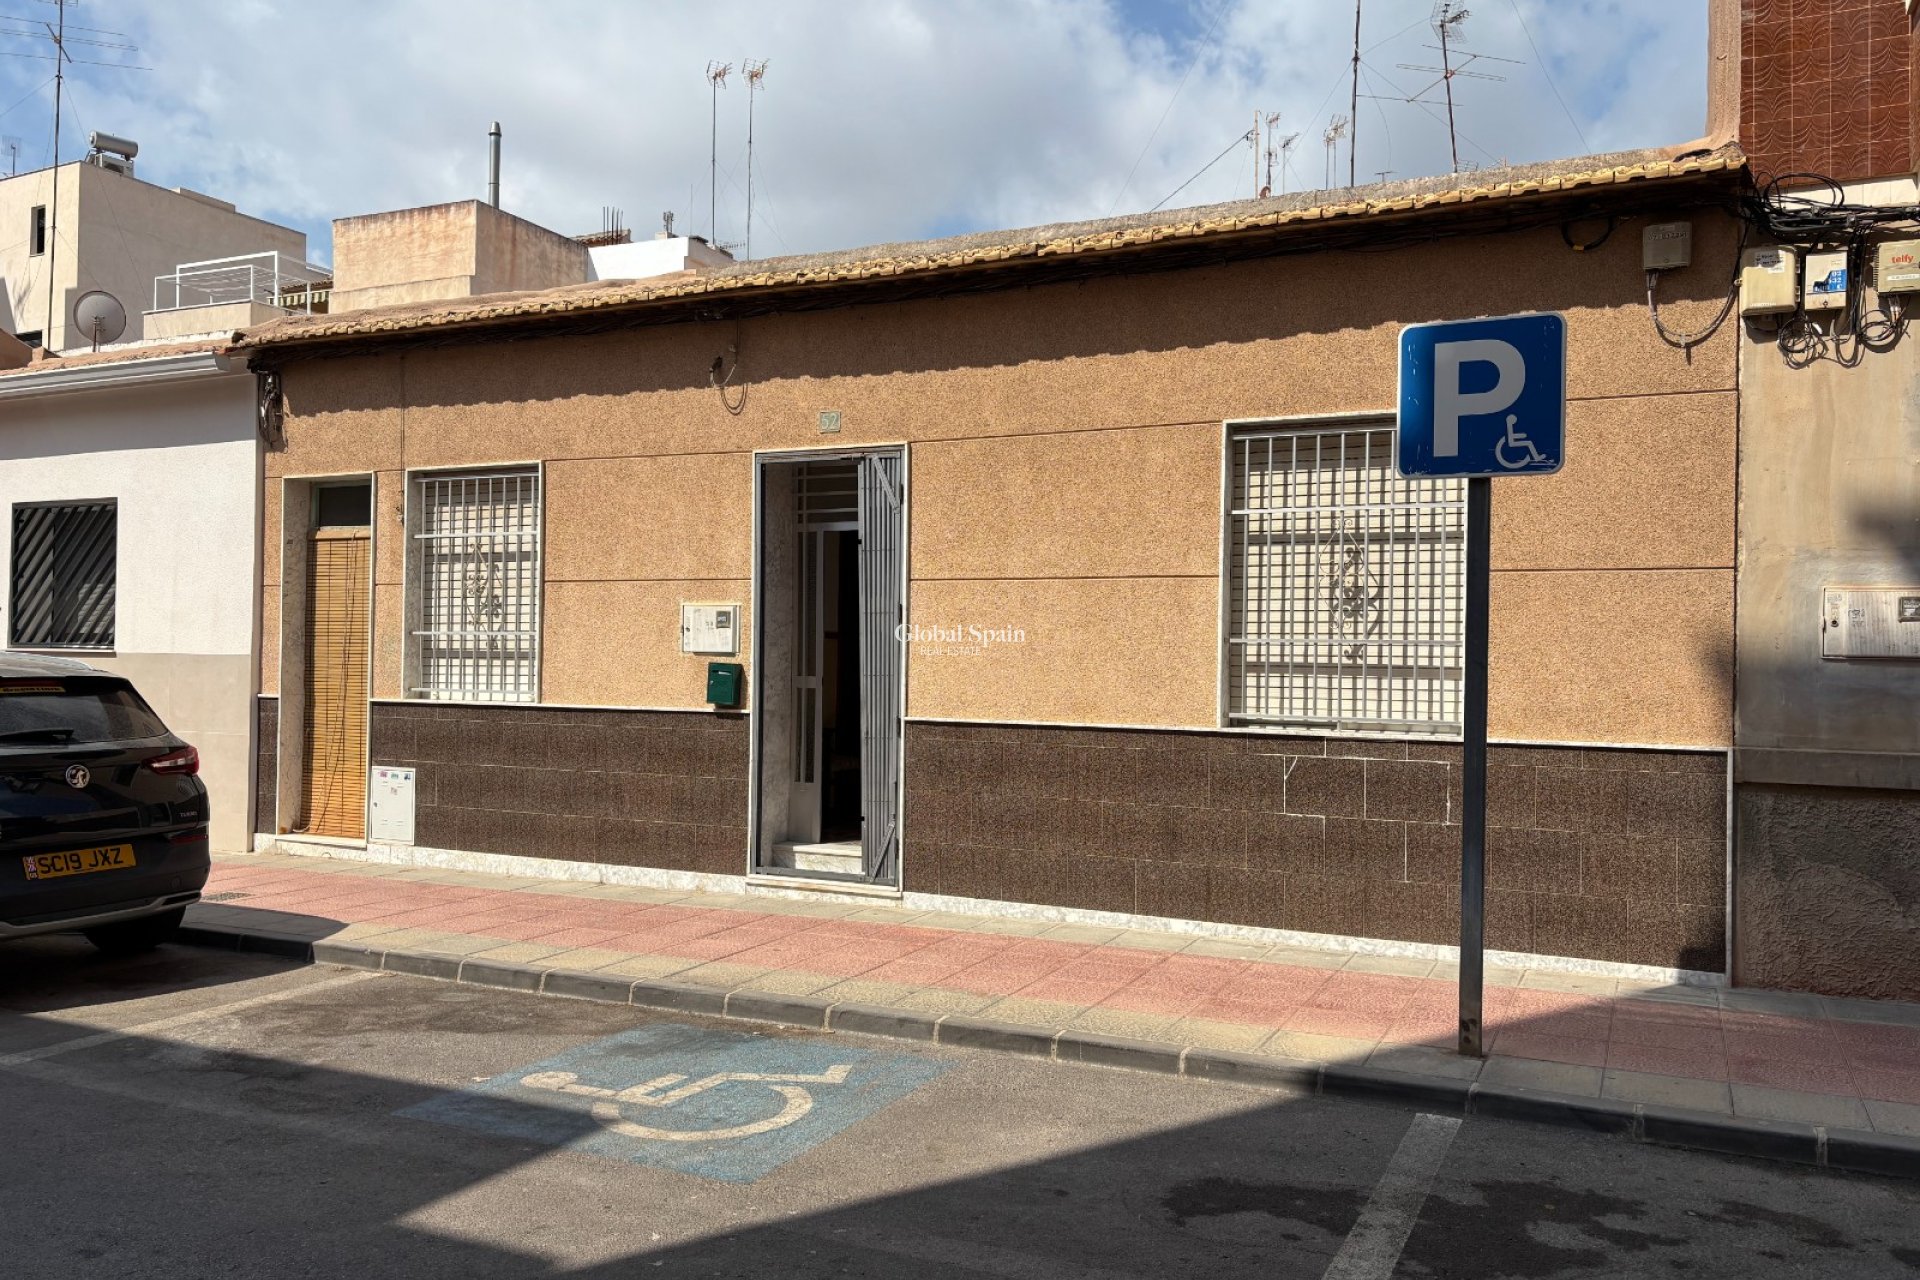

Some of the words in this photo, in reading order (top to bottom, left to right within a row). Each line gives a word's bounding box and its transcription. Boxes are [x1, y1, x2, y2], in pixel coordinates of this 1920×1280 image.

[1433, 339, 1526, 458] P
[821, 413, 838, 430] 52
[37, 853, 82, 874] SC19
[88, 847, 124, 868] JXZ
